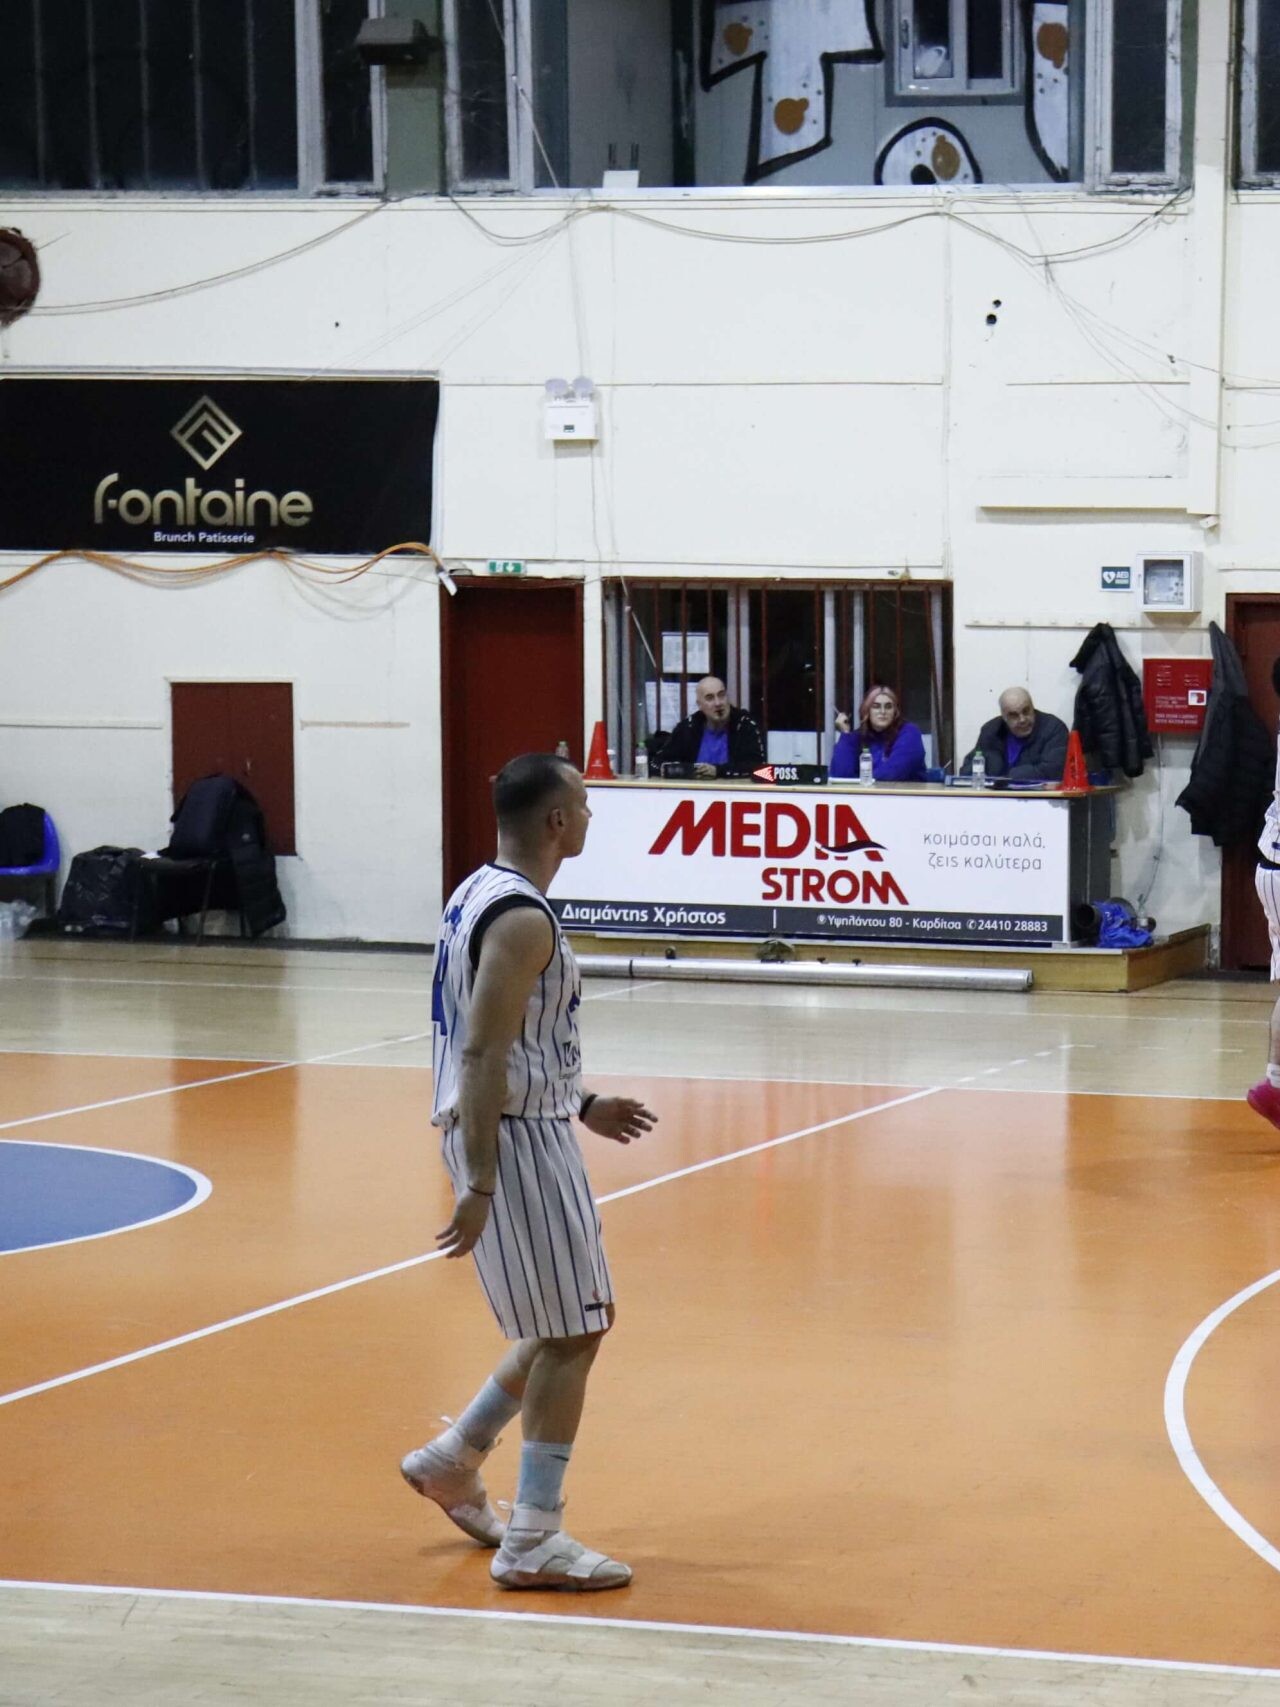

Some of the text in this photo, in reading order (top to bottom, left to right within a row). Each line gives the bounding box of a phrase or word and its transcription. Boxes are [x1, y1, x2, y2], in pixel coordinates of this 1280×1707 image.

[154, 532, 255, 544] Brunch Patisserie
[774, 767, 799, 780] POSS.
[648, 800, 885, 862] MEDIA
[923, 831, 997, 848] κοιμάσαι
[964, 854, 1042, 872] καλύτερα
[761, 867, 909, 905] STROM
[561, 903, 726, 926] Διαμάντης Χρήστος
[889, 917, 902, 928] 80
[913, 917, 962, 931] Καρδίτσα
[978, 919, 1011, 932] 24410
[1014, 920, 1048, 932] 28883
